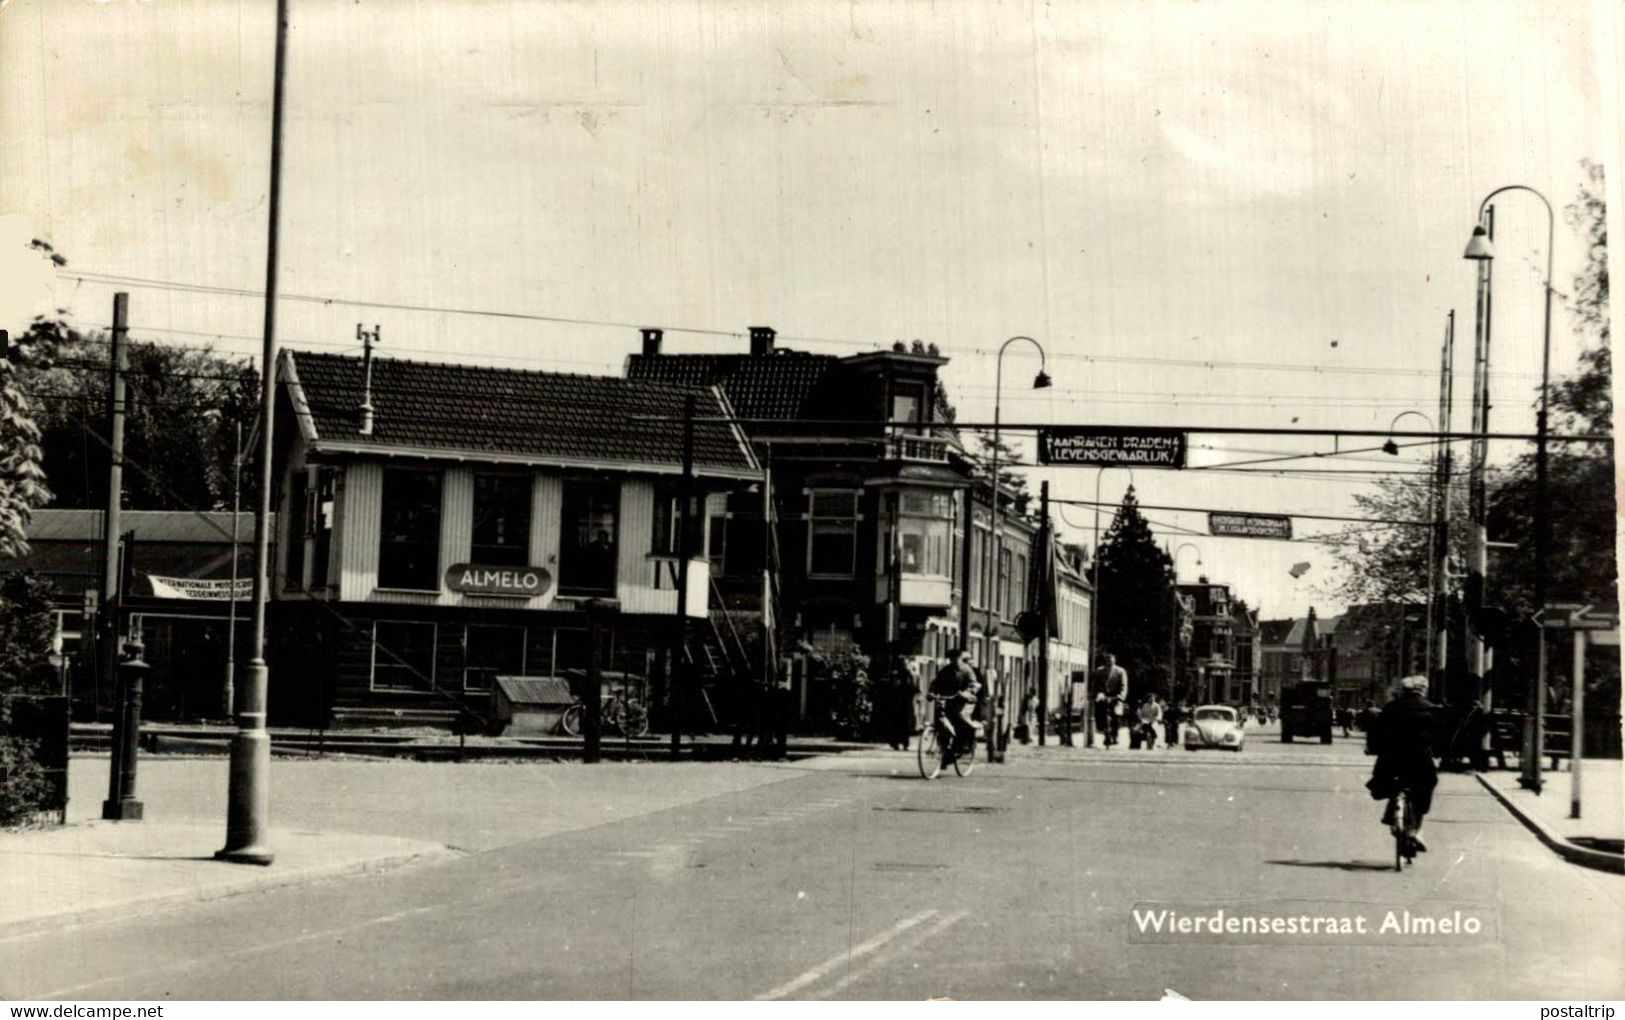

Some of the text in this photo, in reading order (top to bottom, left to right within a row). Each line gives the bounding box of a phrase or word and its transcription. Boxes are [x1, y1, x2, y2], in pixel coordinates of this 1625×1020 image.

[1054, 436, 1172, 449] AANRAKEN DRADEN
[1055, 448, 1170, 462] LEVENSGEVAARLIJK
[460, 570, 538, 589] ALMELO
